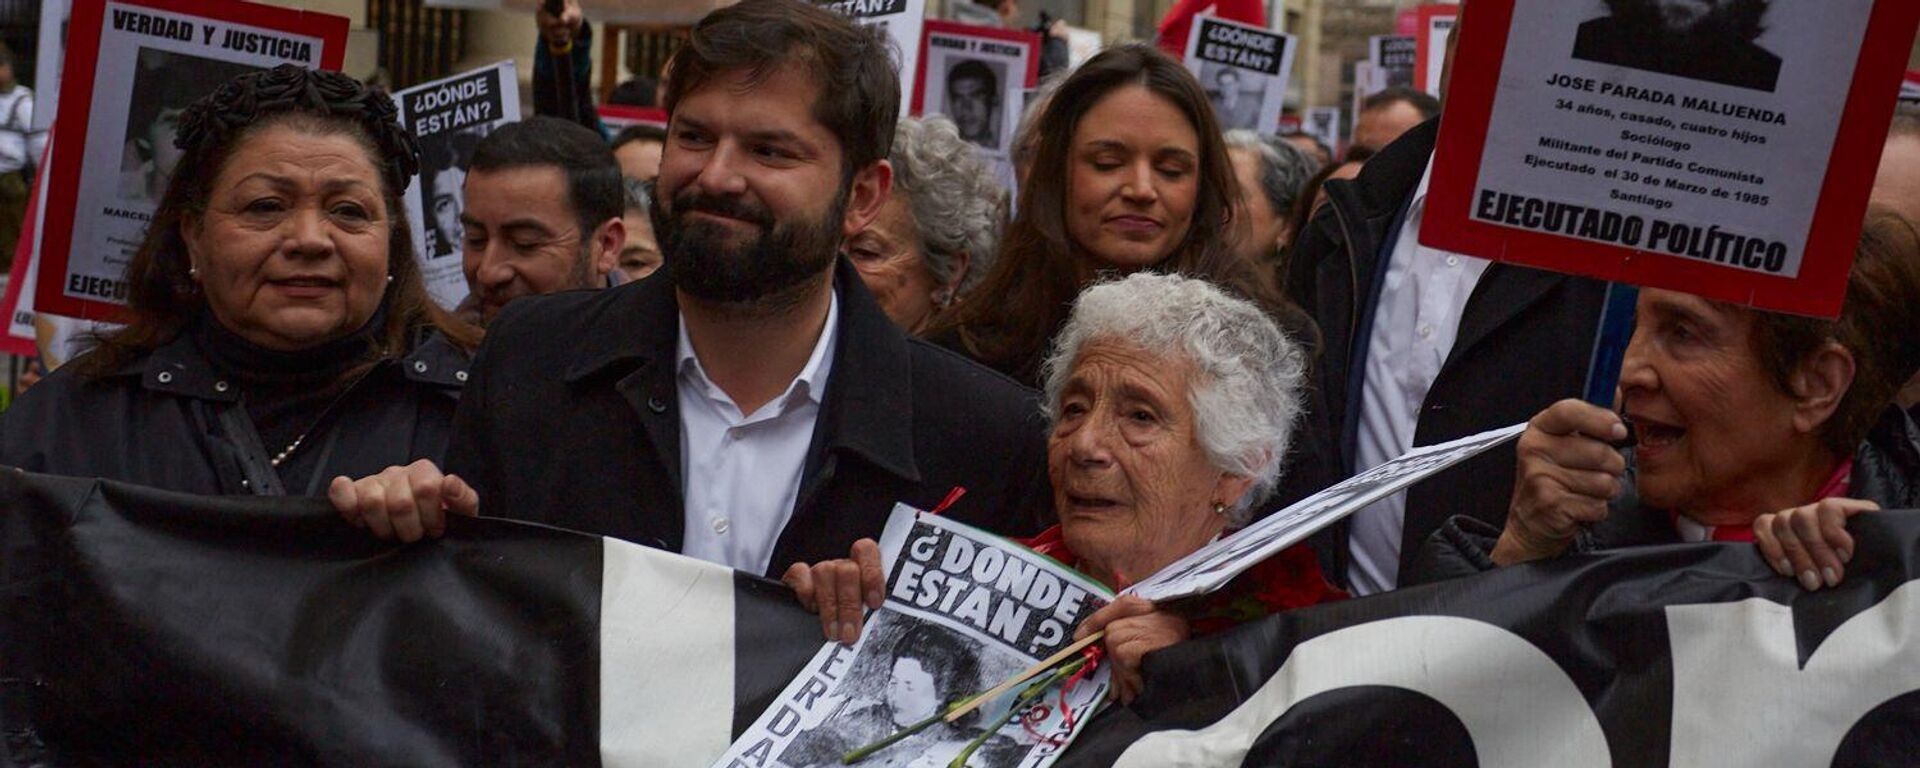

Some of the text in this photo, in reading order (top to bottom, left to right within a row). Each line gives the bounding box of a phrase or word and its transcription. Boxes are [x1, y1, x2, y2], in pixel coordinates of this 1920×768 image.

[113, 9, 312, 62] VERDAD Y JUSTICIA
[414, 77, 488, 113] ¿DÓNDE
[1546, 73, 1787, 126] JOSE PARADA MALUENDA
[416, 101, 491, 137] ESTÁN?
[1555, 98, 1766, 145] 34 años, casado, cuatro hijos
[1620, 130, 1691, 152] Sociólogo
[1524, 154, 1769, 206] Ejecutado el 30 de Marzo de 1985
[1538, 137, 1764, 185] Militante del Partido Comunista
[1609, 188, 1673, 210] Santiago
[1476, 189, 1788, 273] EJECUTADO POLÍTICO
